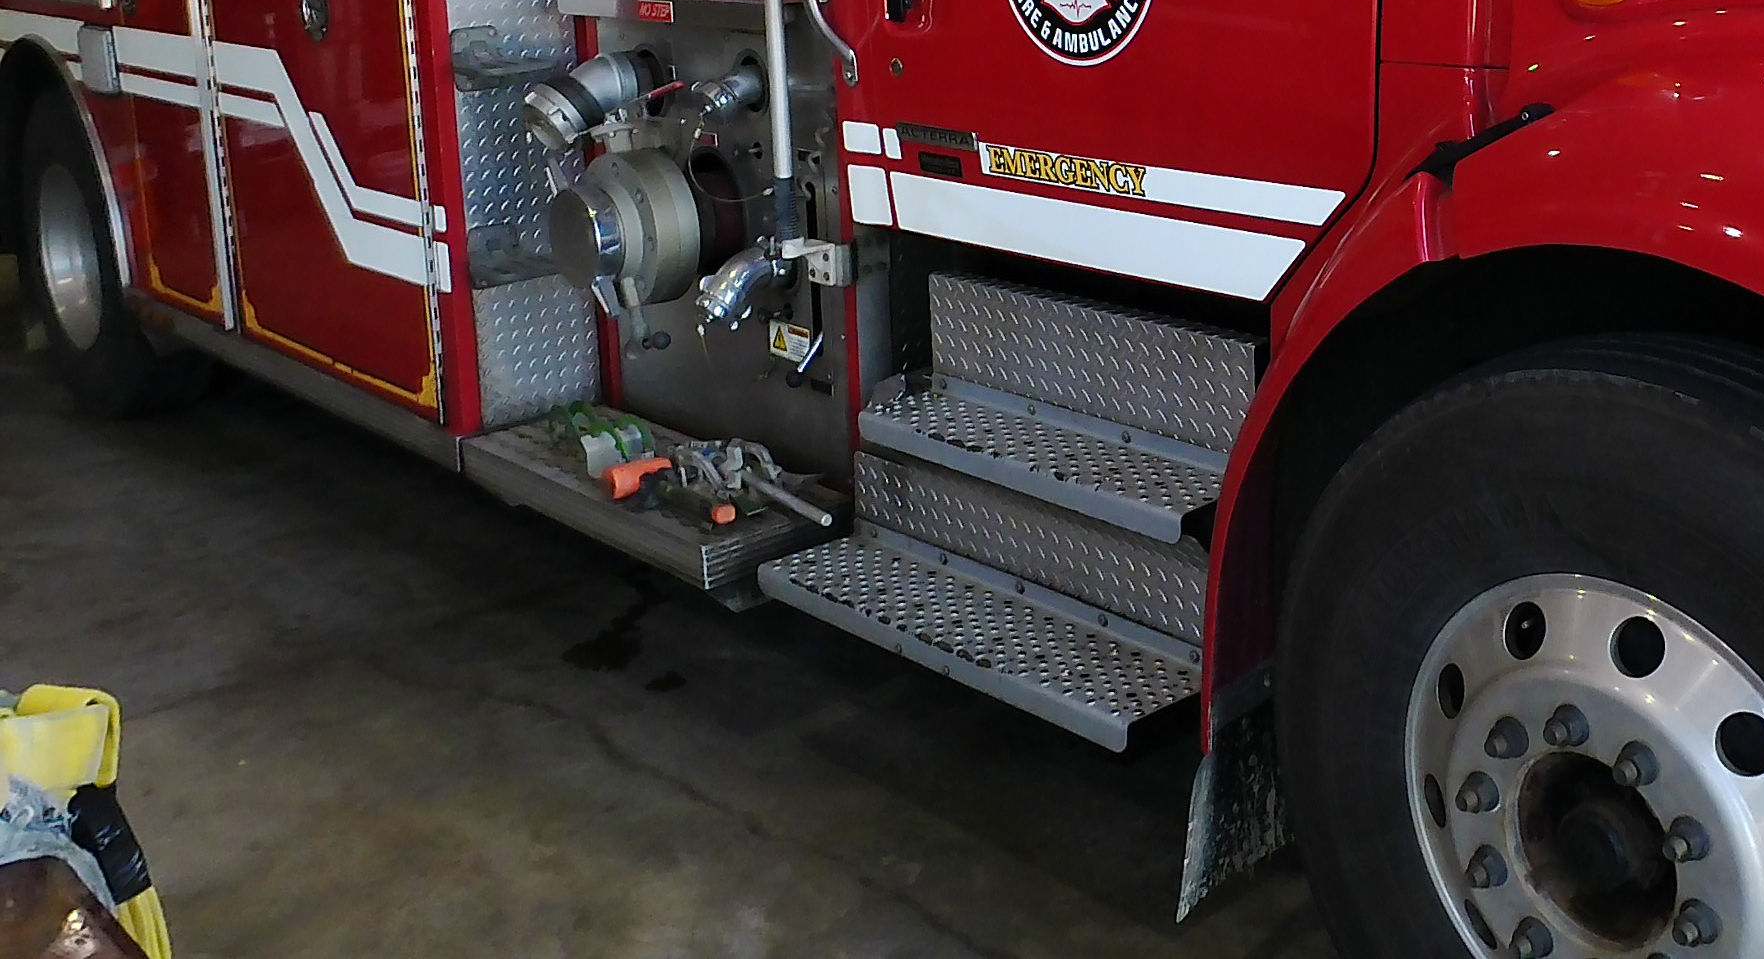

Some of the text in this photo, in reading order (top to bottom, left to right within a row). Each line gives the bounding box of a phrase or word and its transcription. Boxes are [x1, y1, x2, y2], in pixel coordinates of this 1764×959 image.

[639, 2, 670, 18] NO STEP
[986, 144, 1147, 197] EMERGENCY
